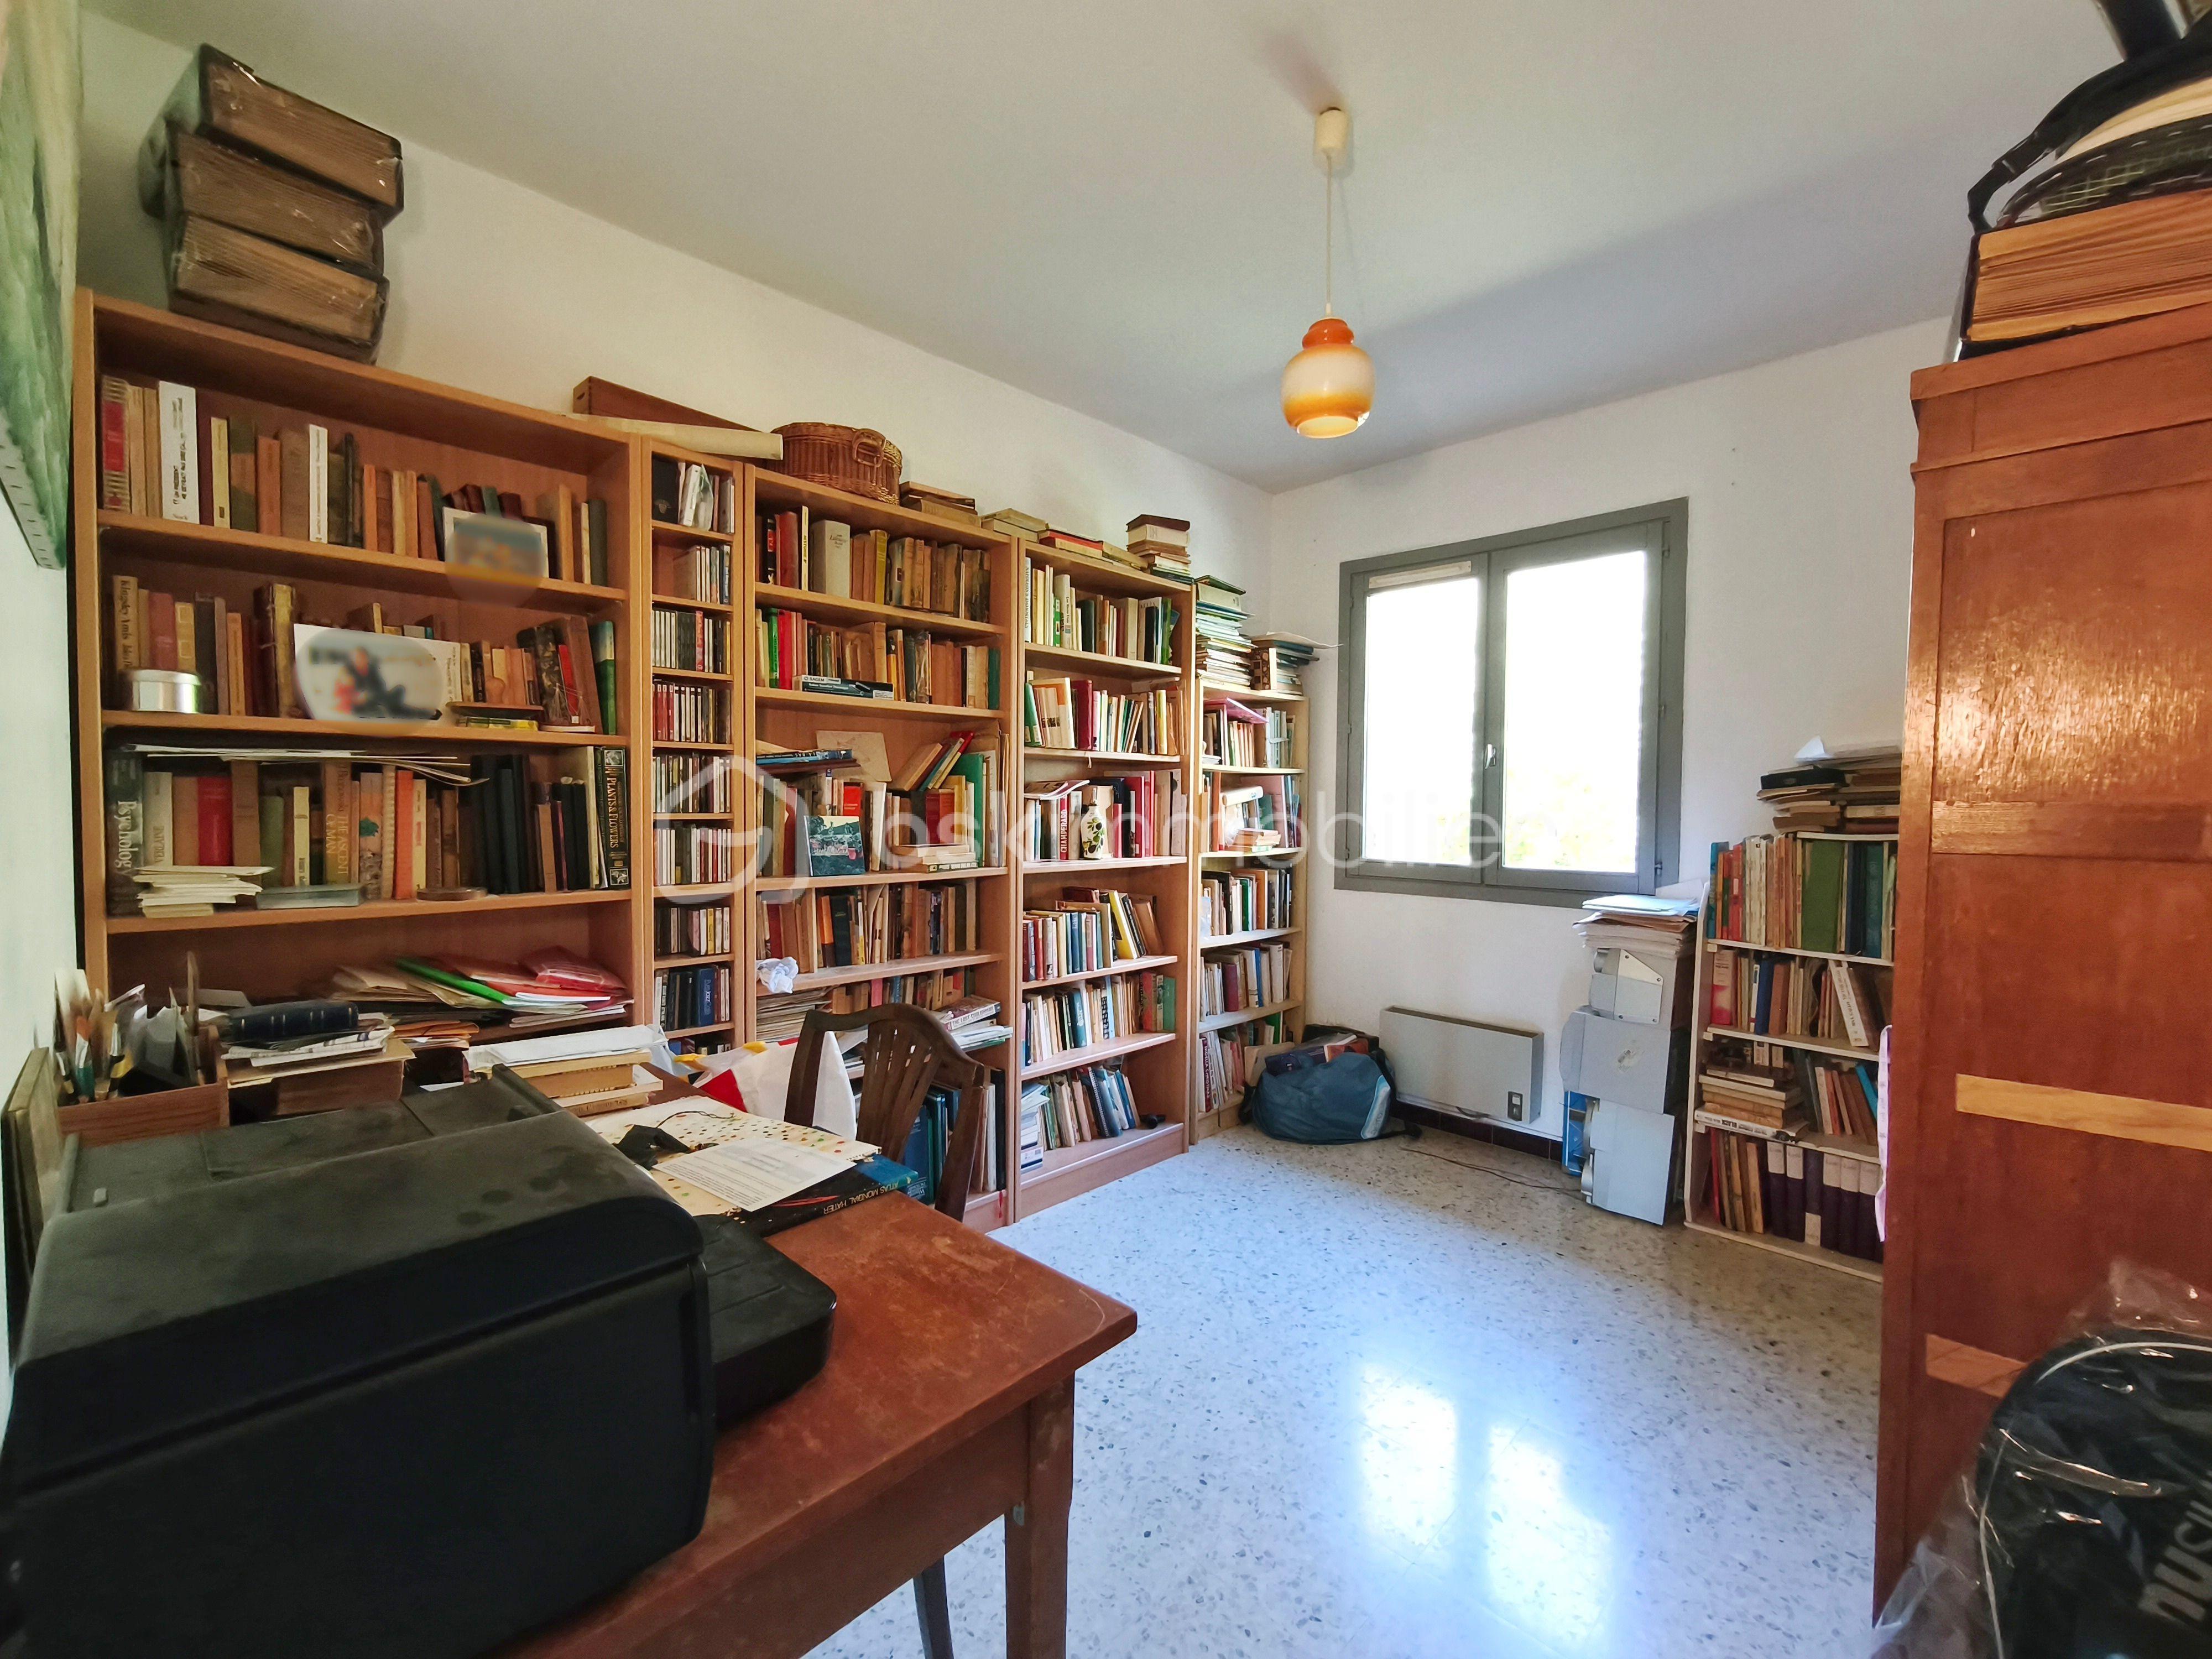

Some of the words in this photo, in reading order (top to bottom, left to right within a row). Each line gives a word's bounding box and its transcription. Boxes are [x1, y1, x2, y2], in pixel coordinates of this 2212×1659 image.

[607, 777, 617, 806] PLANTS
[326, 814, 336, 828] OF
[337, 814, 348, 836] THE
[608, 813, 619, 848] FLOWERS
[114, 800, 139, 877] Psychology
[326, 830, 336, 855] MAN
[337, 836, 349, 876] ASCENT
[849, 1187, 879, 1203] MONDIAL
[880, 1181, 899, 1194] ATLAS
[823, 1201, 847, 1215] HATIER
